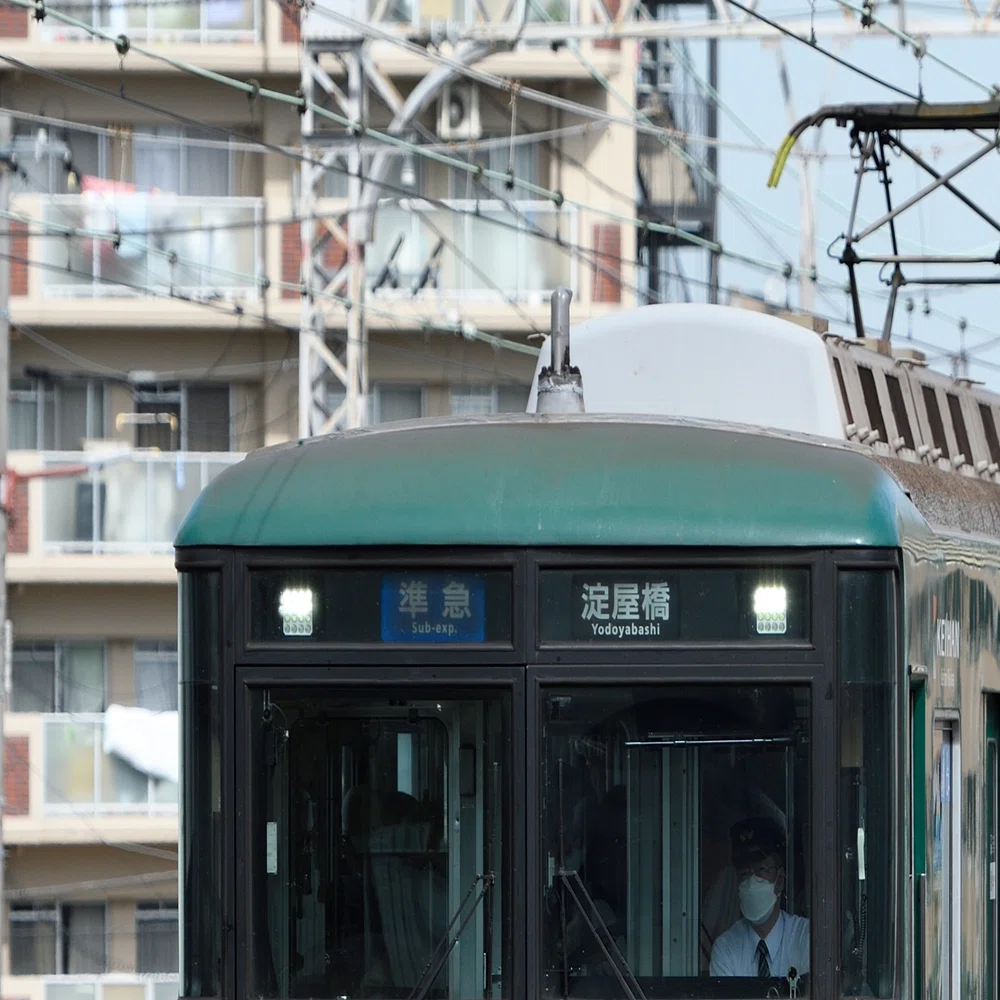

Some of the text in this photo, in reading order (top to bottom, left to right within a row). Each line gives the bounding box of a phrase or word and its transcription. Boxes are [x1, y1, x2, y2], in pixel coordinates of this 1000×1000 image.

[399, 581, 472, 618] 準急
[581, 582, 670, 620] 淀屋橋
[412, 621, 457, 636] Sub-exp.
[591, 622, 660, 638] Yodoyabashi
